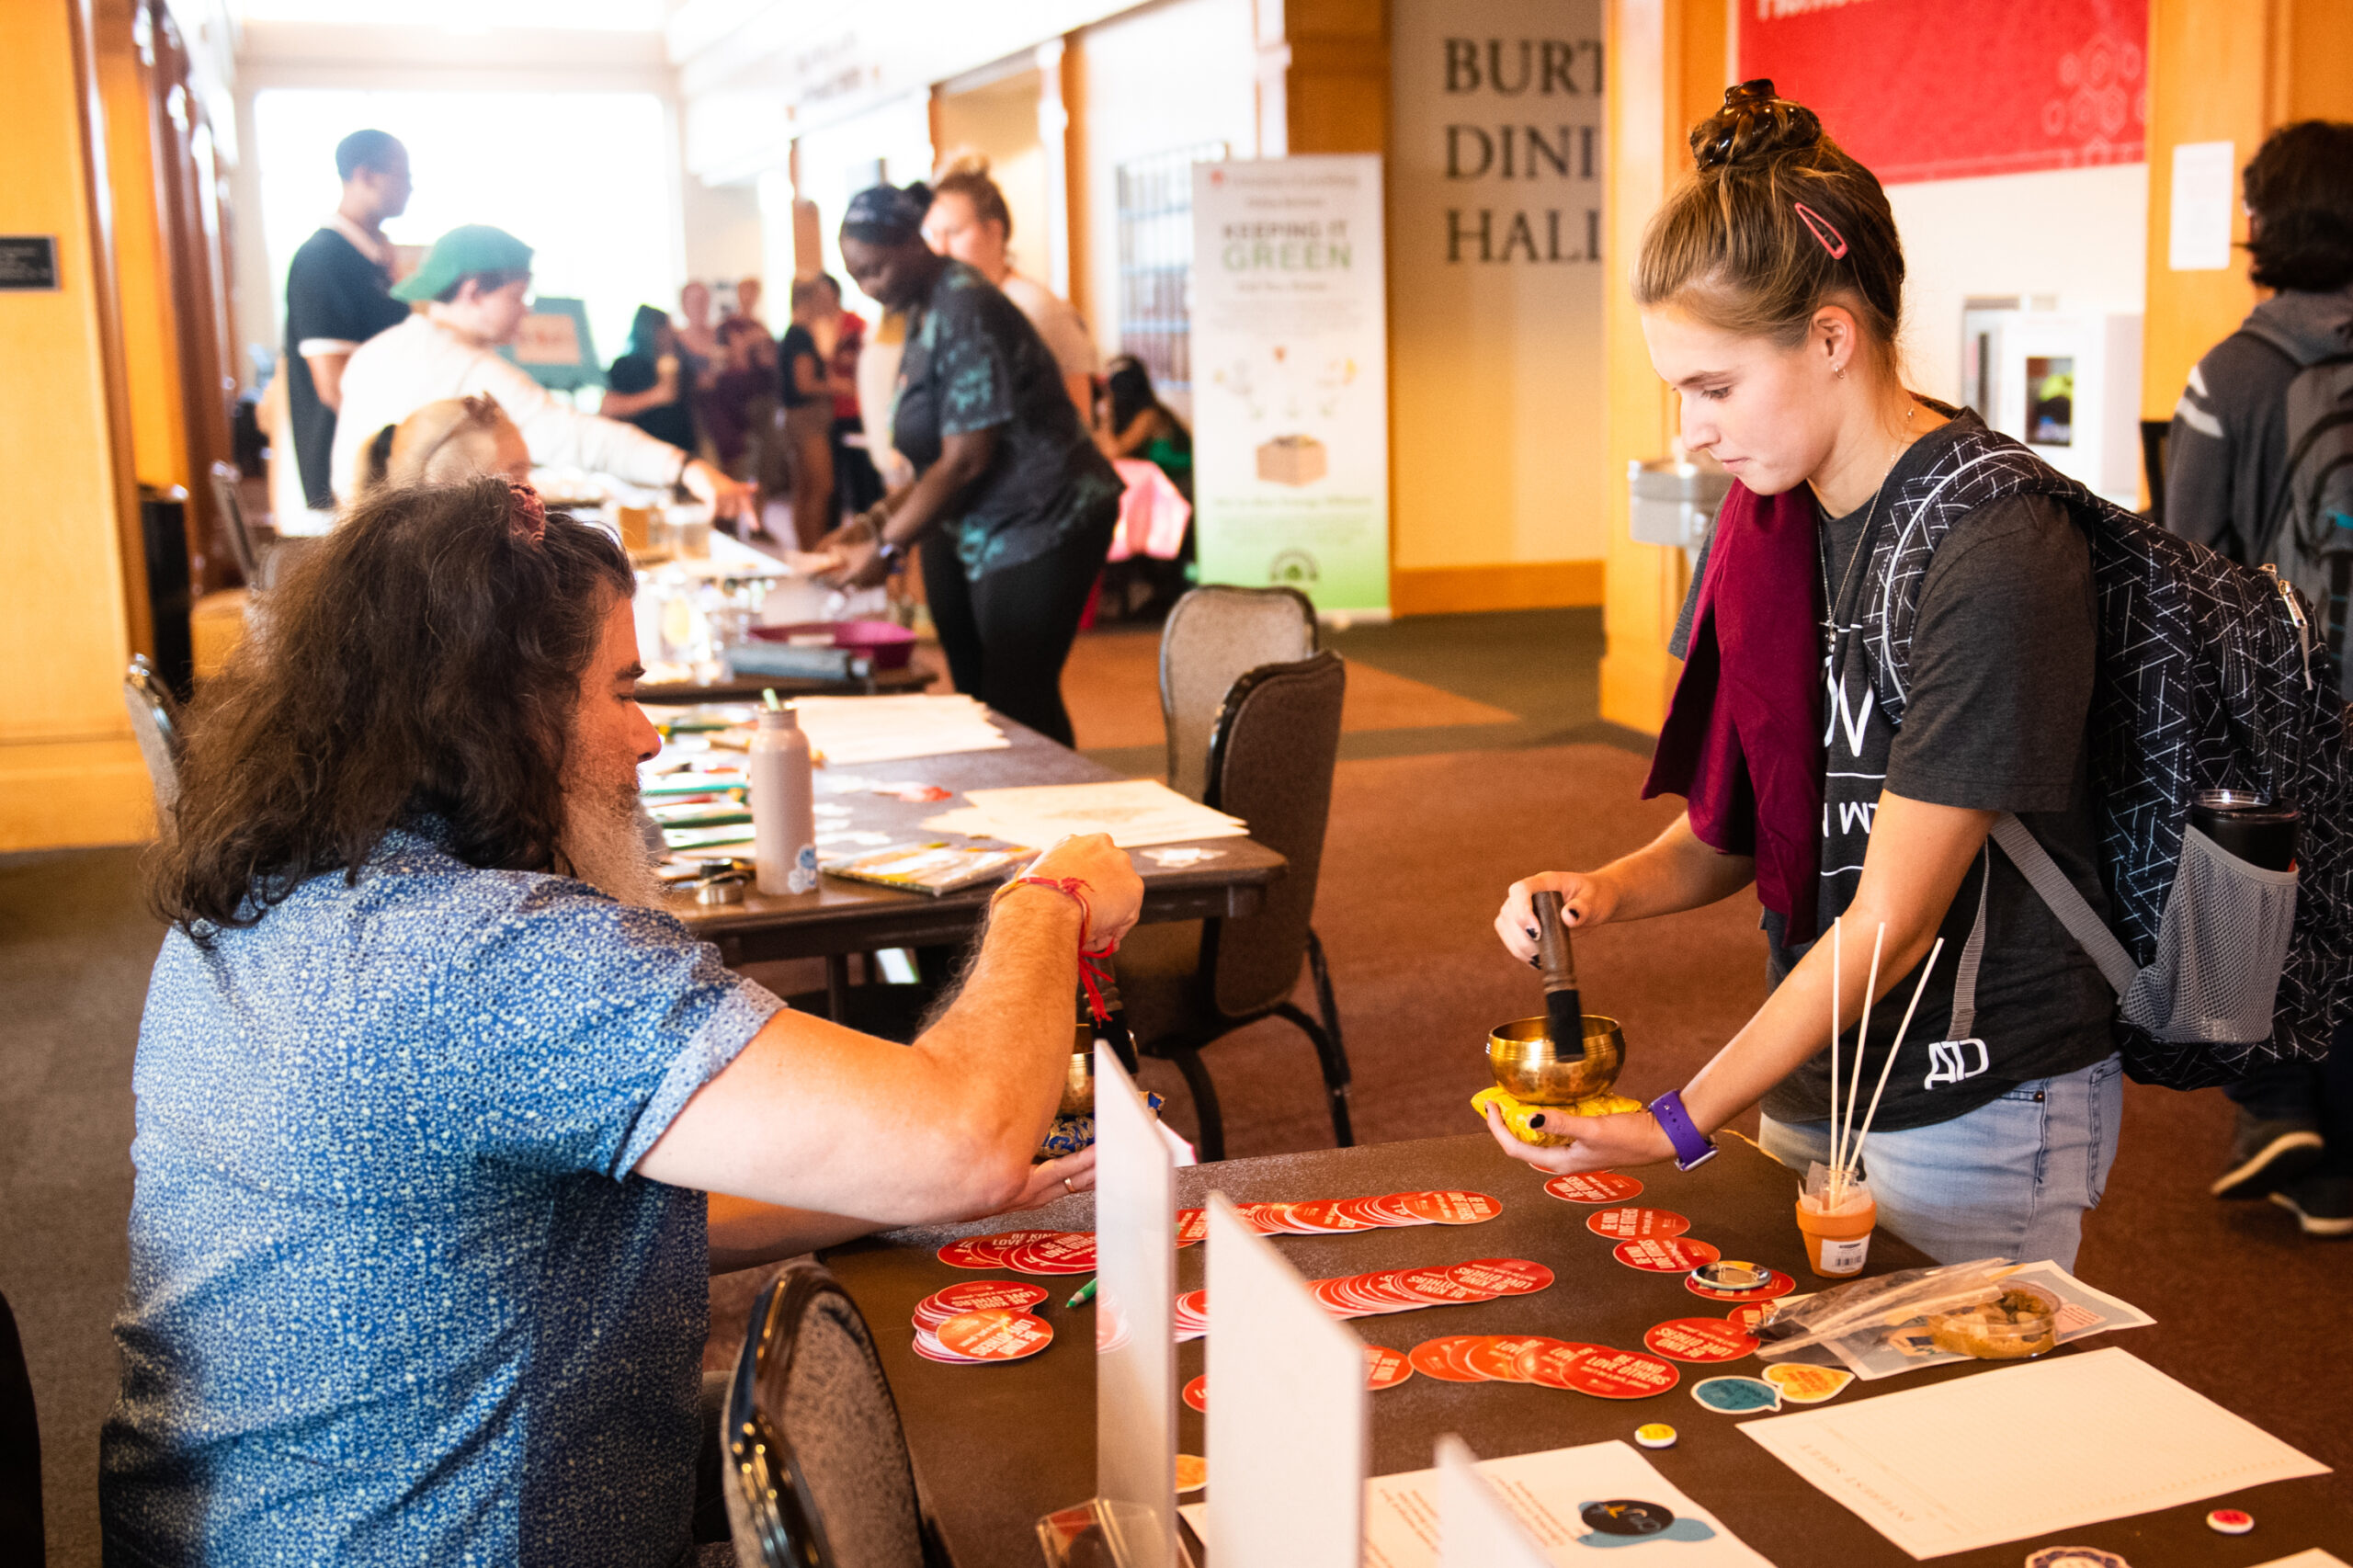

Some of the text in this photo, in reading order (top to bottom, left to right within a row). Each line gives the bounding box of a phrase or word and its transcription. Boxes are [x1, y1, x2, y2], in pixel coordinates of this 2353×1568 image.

[1223, 243, 1351, 270] GREEN
[1040, 1247, 1072, 1258] LOVE
[1415, 1284, 1449, 1295] KIND
[1459, 1276, 1508, 1291] BE KIND
[1507, 1278, 1533, 1290] LOVE
[1447, 1289, 1467, 1299] BE
[1655, 1338, 1706, 1358] BE KIND
[1700, 1342, 1734, 1357] LOVE
[1586, 1356, 1620, 1370] LOVE
[1613, 1354, 1666, 1374] BE KIND
